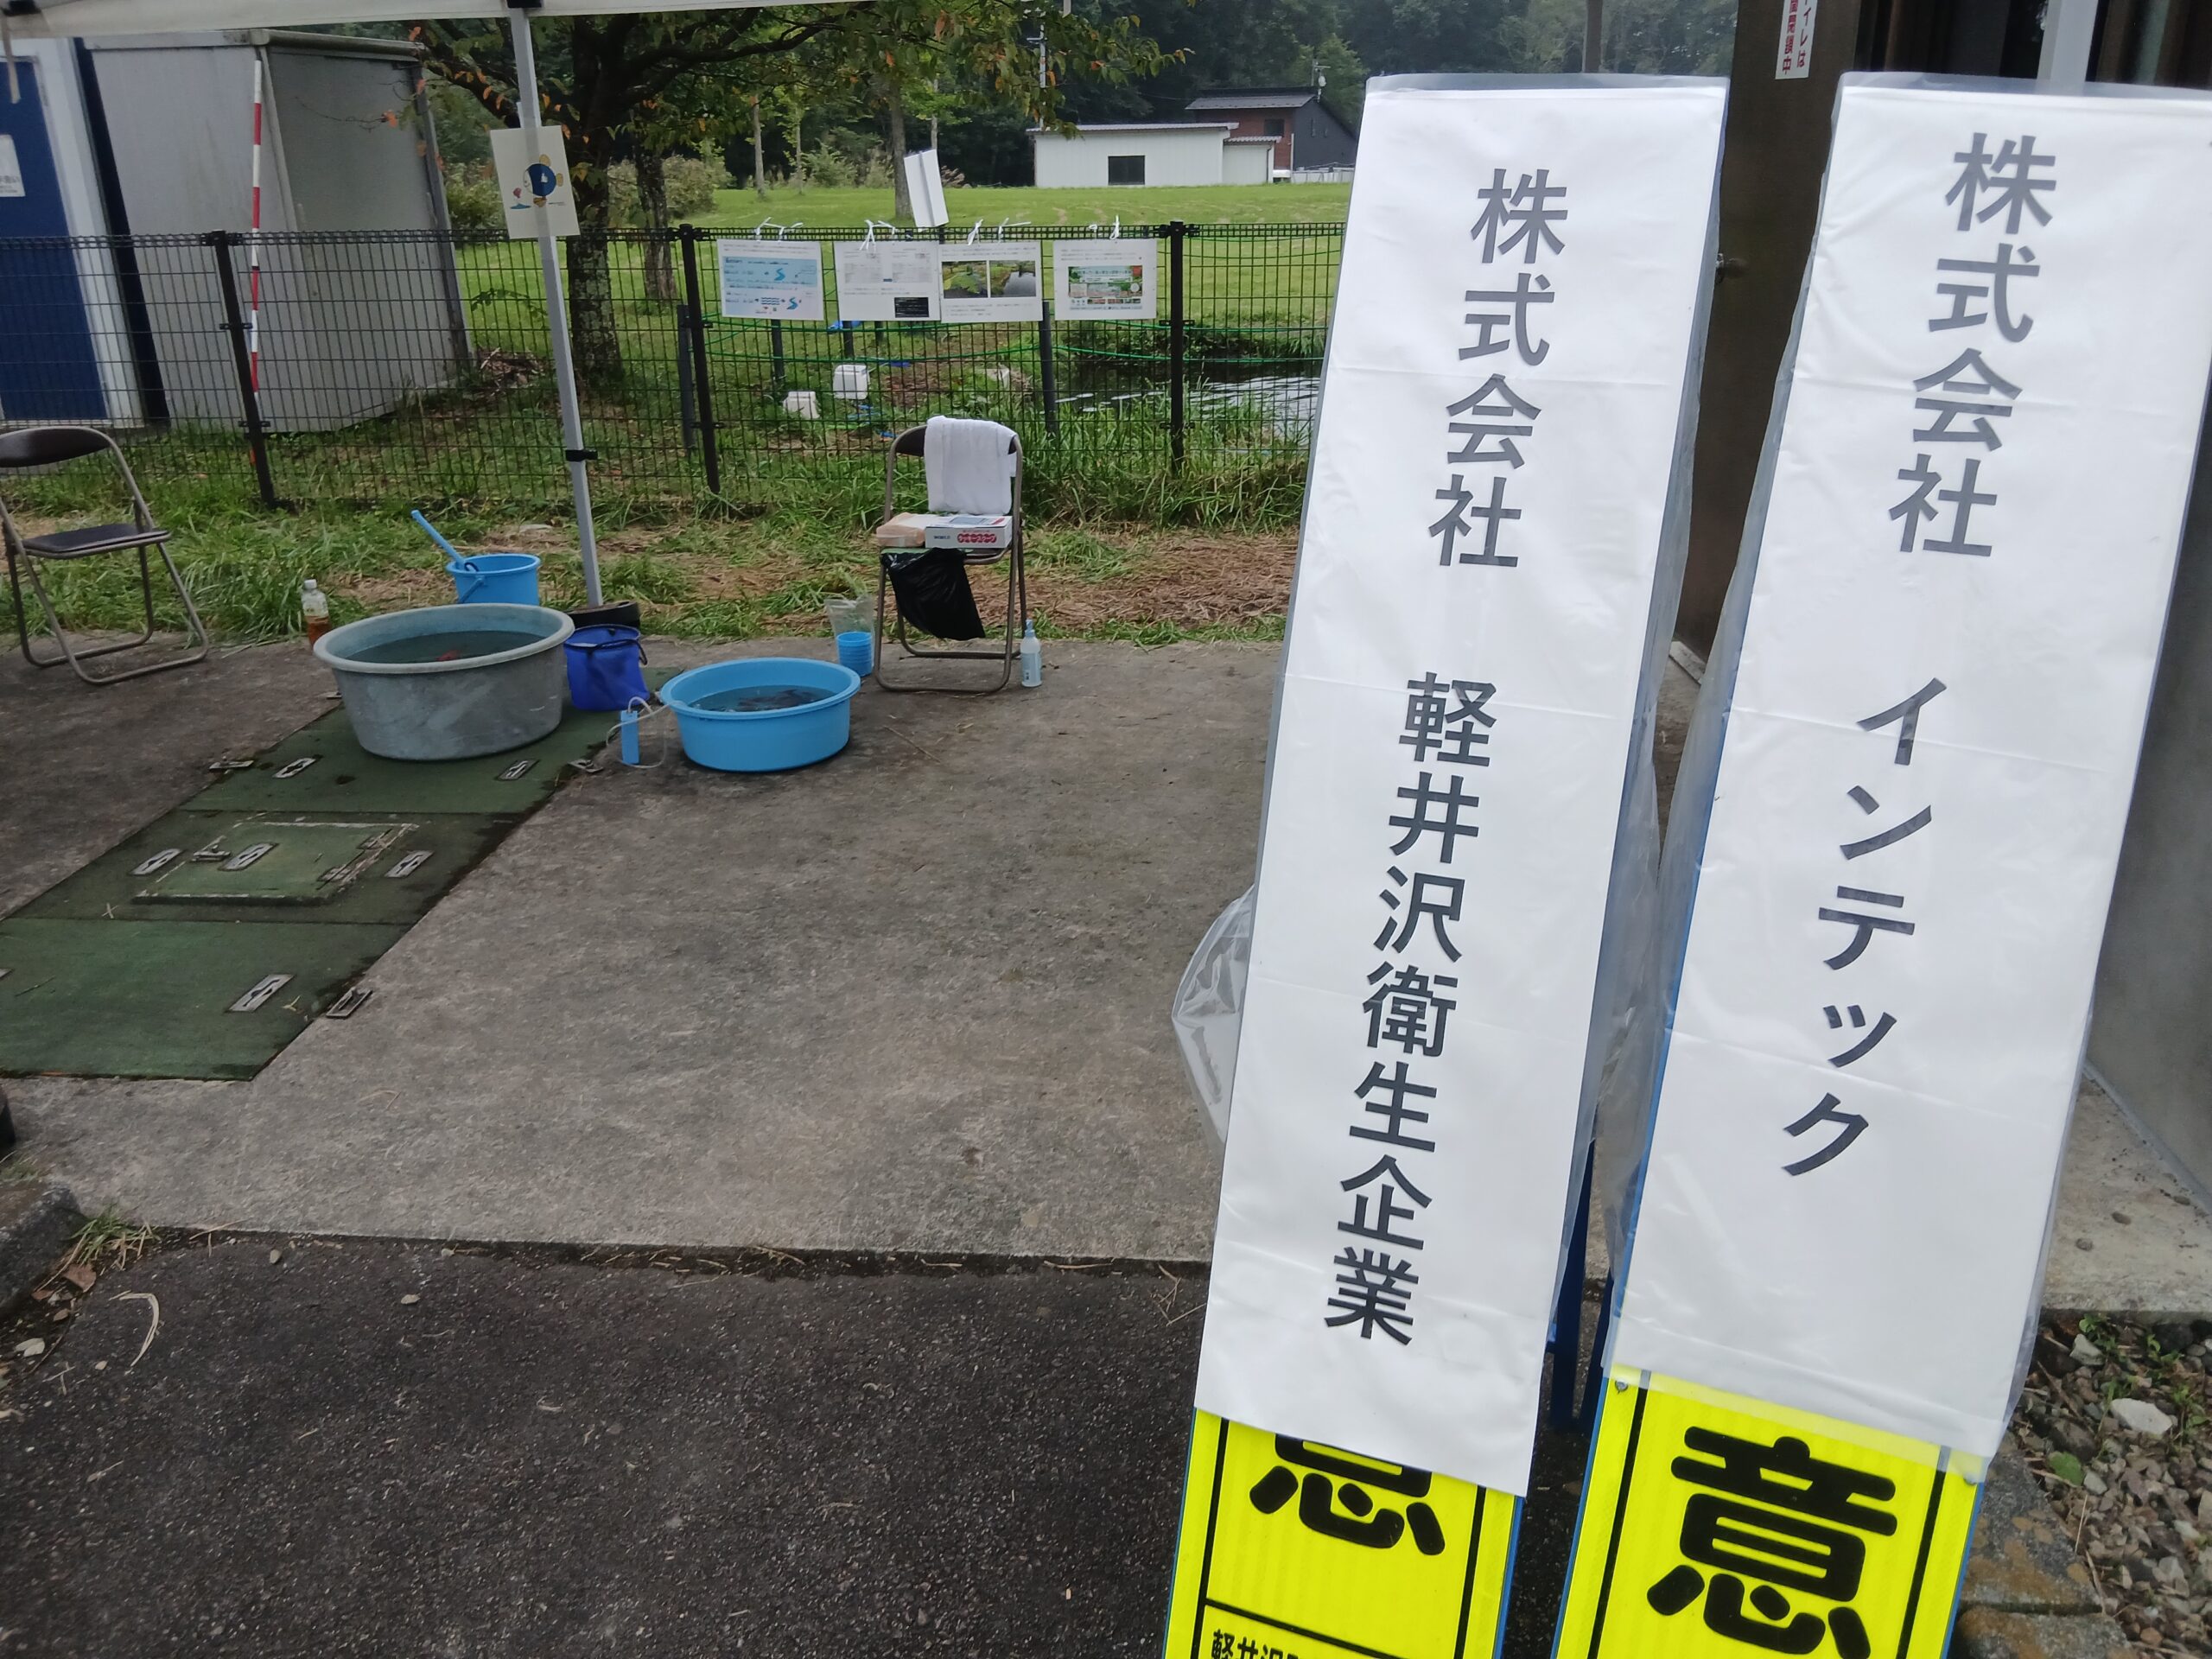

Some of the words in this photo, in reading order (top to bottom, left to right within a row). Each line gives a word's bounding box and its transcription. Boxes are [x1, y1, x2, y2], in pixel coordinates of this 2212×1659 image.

[1797, 0, 1812, 67] イレは
[1428, 168, 1568, 568] 株式会社
[1889, 132, 2056, 557] 株式会社
[1324, 671, 1497, 1345] 軽井沢衛生企業
[1782, 677, 1948, 1176] インテック
[1647, 1426, 1897, 1659] 意
